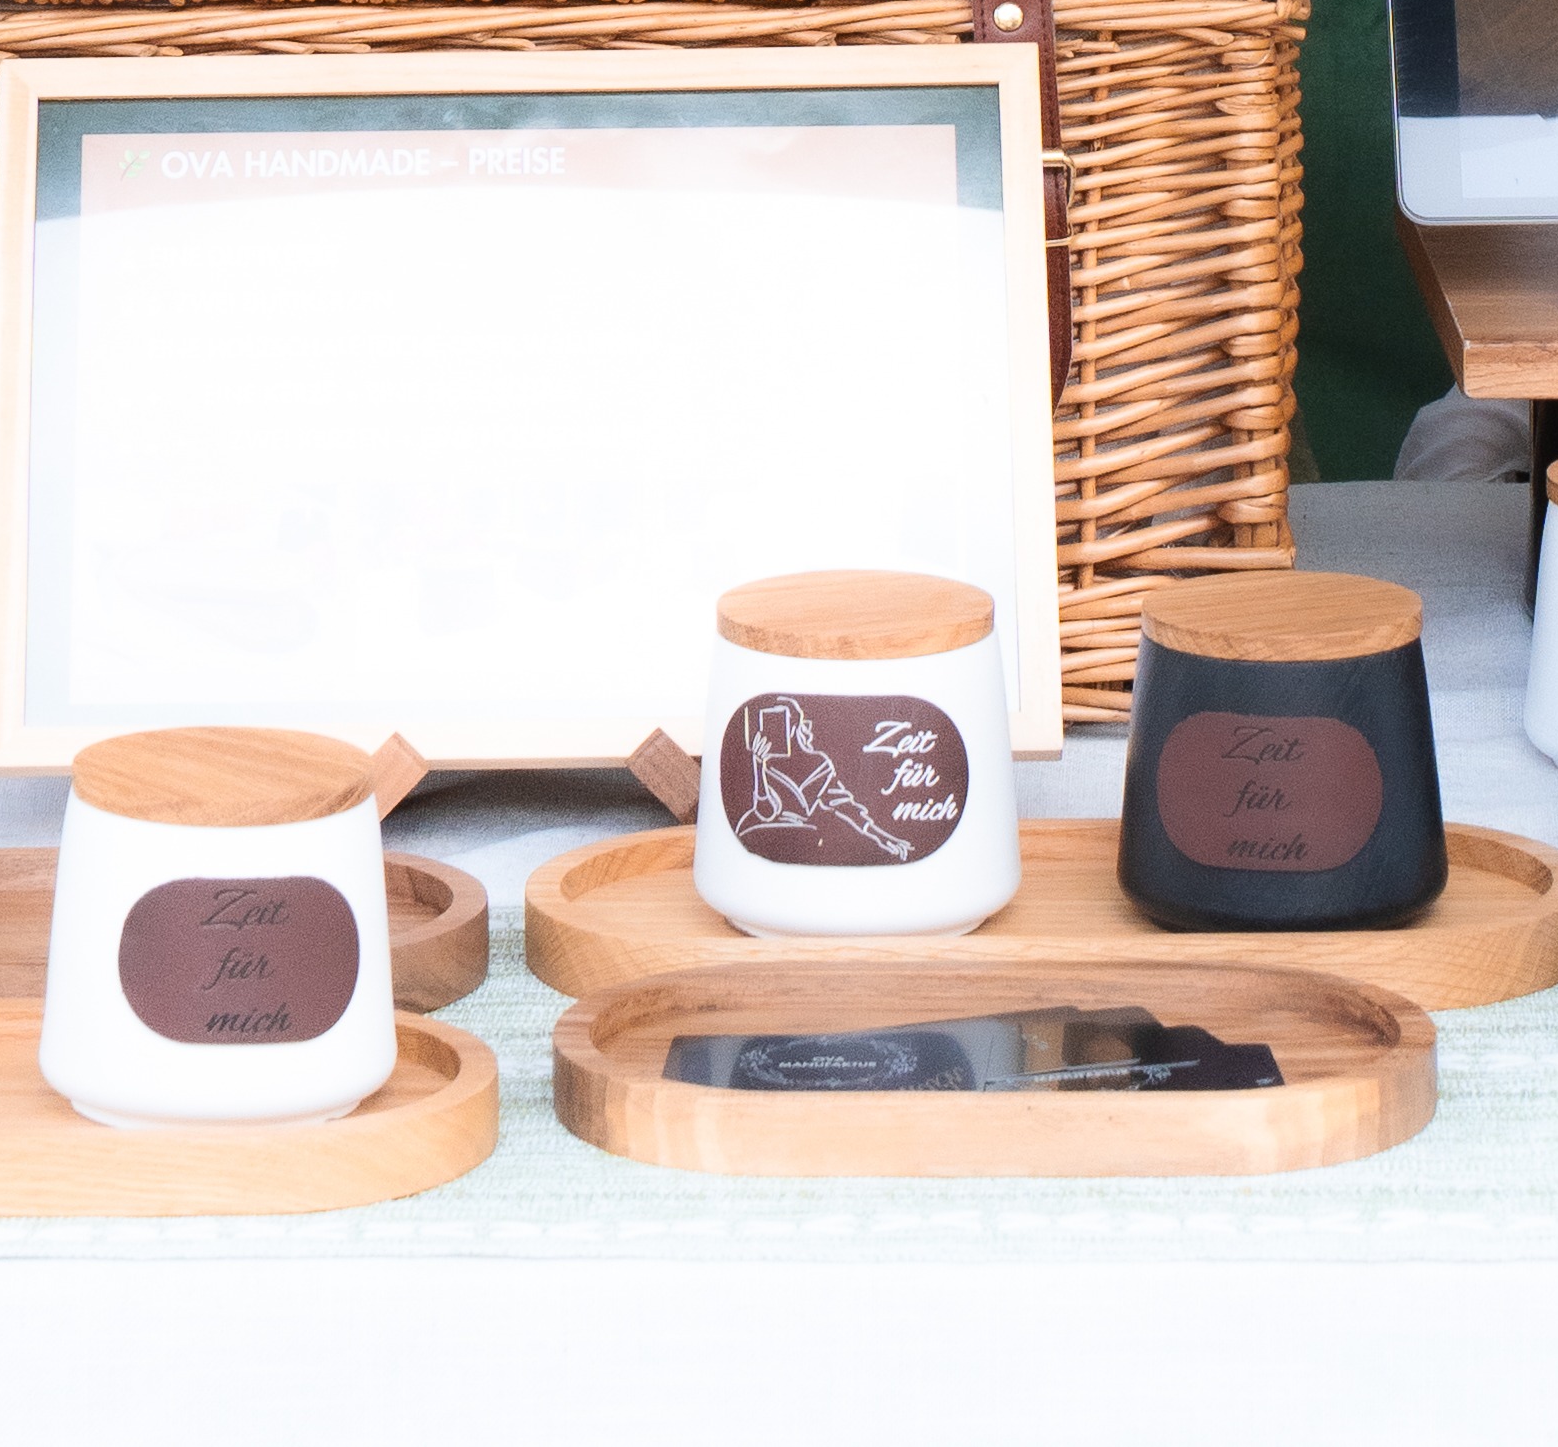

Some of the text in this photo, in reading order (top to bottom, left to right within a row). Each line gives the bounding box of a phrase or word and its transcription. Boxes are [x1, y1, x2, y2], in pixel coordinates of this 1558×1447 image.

[160, 150, 235, 179] OVA
[245, 147, 431, 179] HANDMADE
[467, 146, 566, 175] PREISE
[863, 720, 938, 758] Zeit
[1221, 726, 1307, 765] Zeit
[881, 758, 940, 796] für
[891, 793, 959, 821] mich
[1223, 779, 1293, 818] für
[1227, 833, 1308, 861] mich
[200, 888, 291, 930] Zeit
[201, 946, 274, 991] für
[205, 1002, 292, 1033] mich
